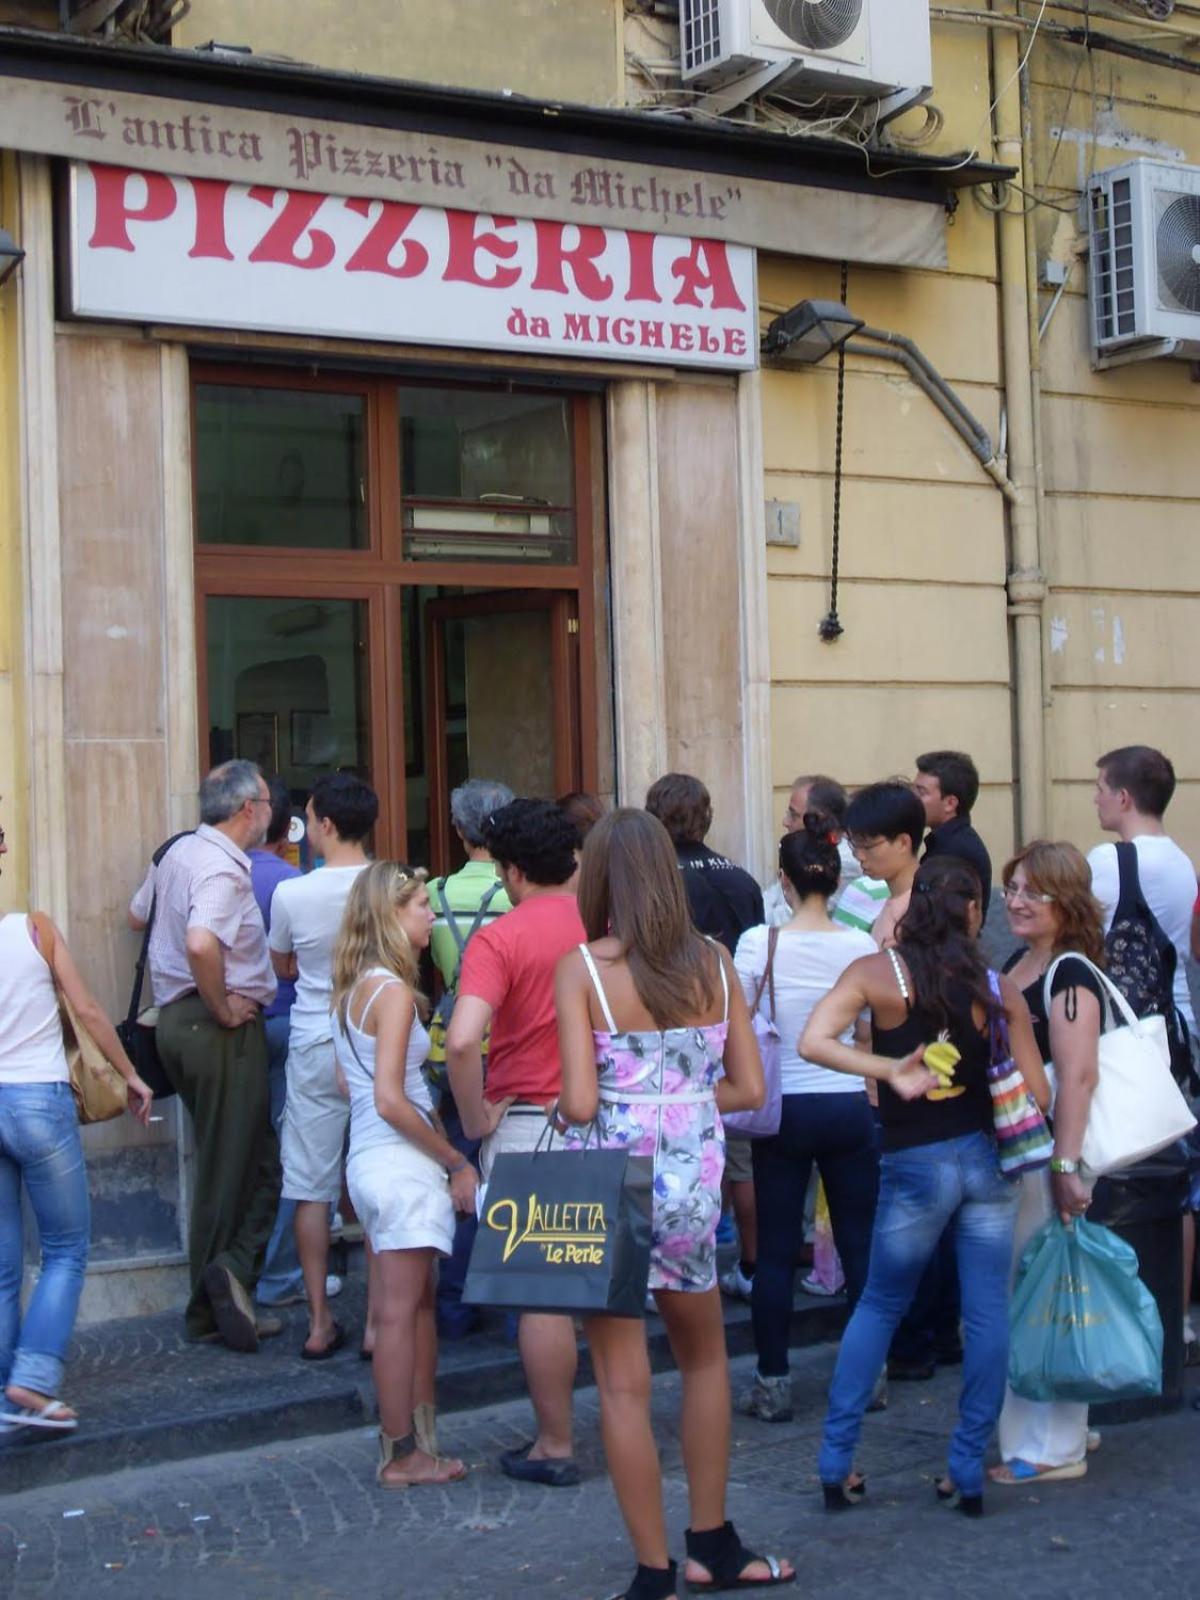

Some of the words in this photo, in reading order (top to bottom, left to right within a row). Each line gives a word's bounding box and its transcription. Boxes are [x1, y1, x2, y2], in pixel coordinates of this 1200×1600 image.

[64, 96, 263, 163] L'antica
[286, 126, 467, 190] Pizzeria
[486, 154, 557, 199] "da
[569, 166, 743, 225] Michele"
[87, 161, 747, 313] PIZZERIA
[506, 307, 551, 339] da
[562, 312, 747, 357] MICHELE
[487, 1193, 607, 1264] VALLETTA
[546, 1244, 562, 1265] Le
[564, 1244, 605, 1265] Perle
